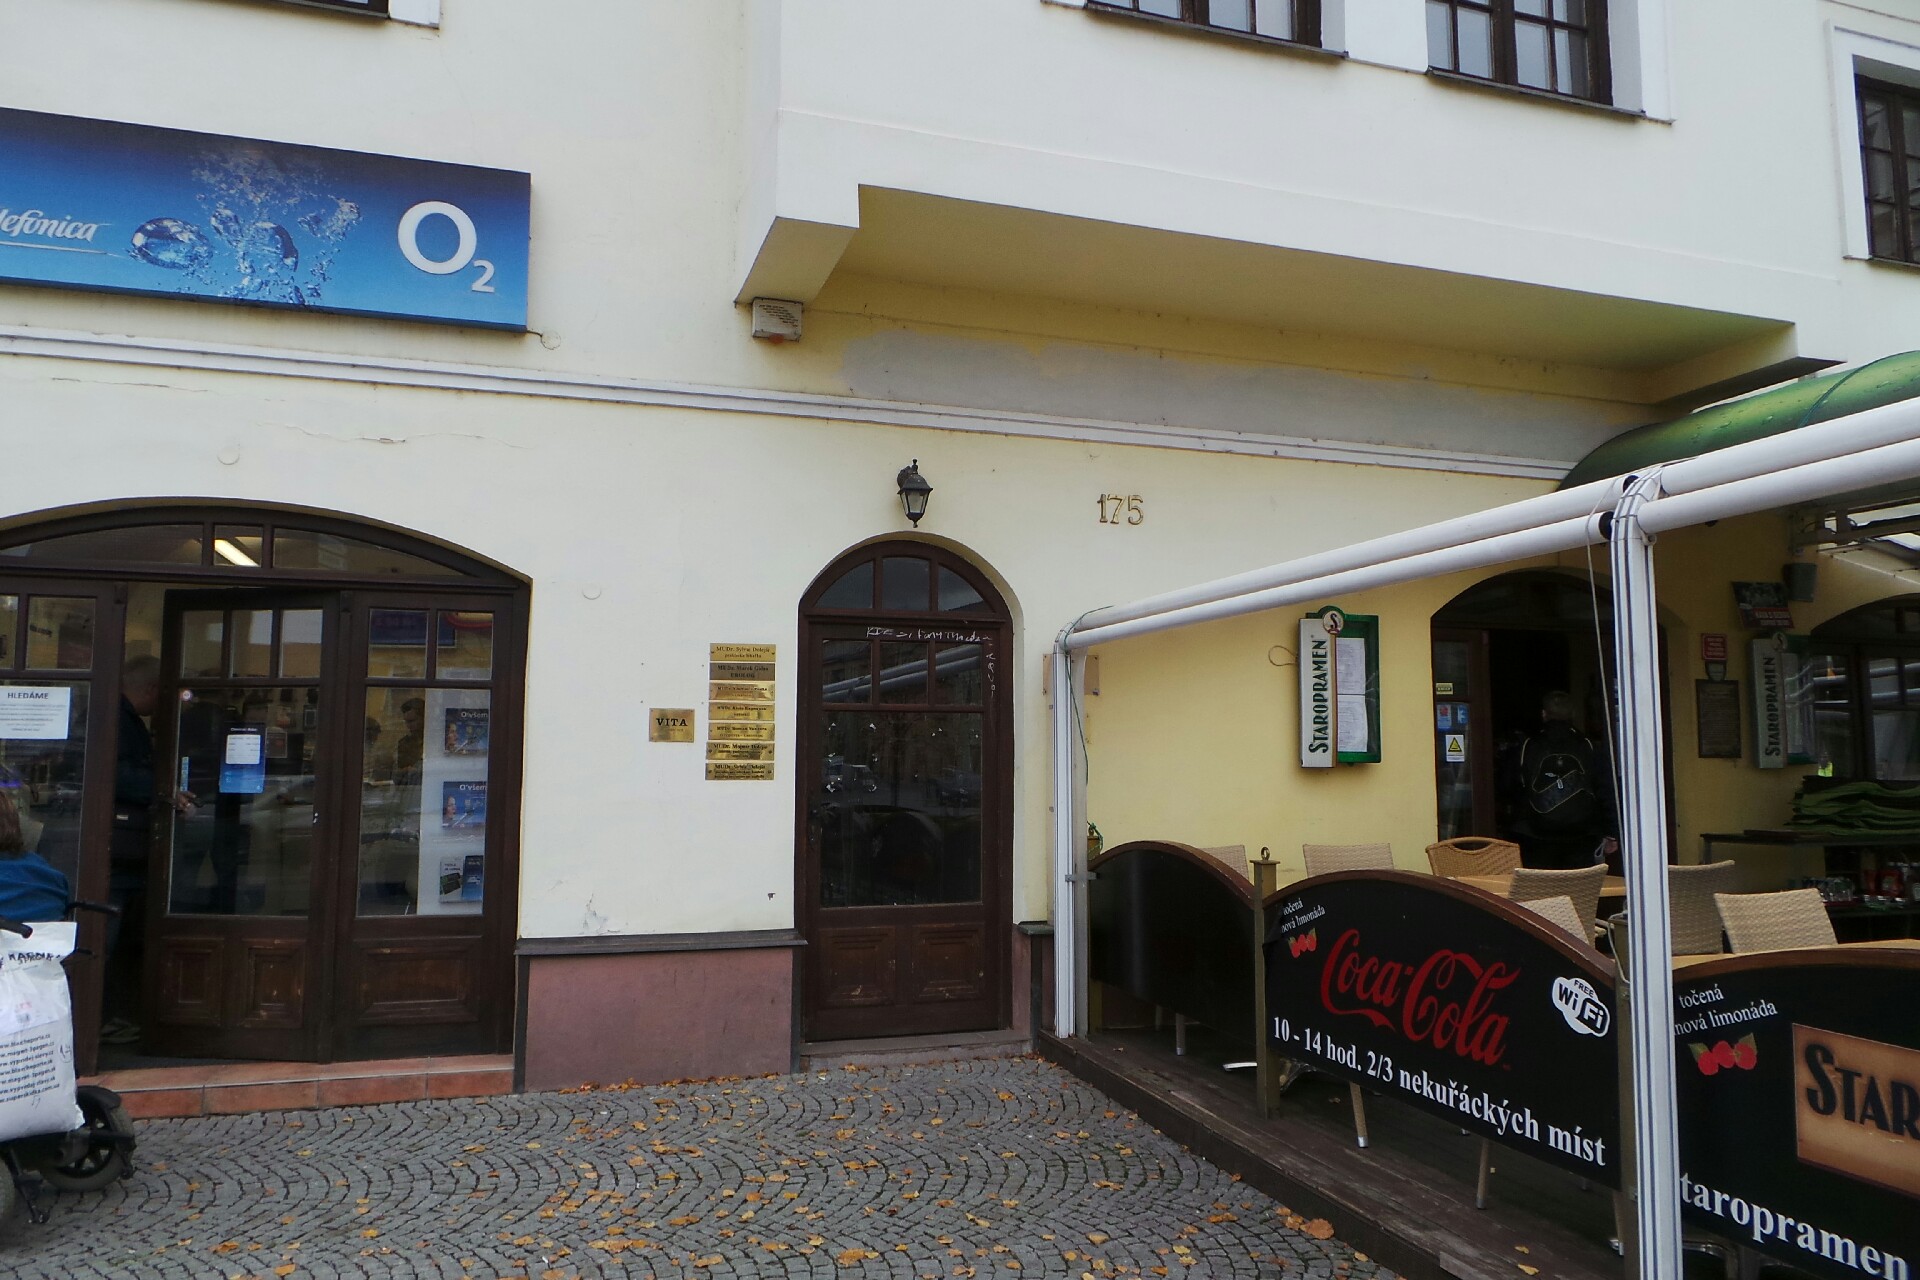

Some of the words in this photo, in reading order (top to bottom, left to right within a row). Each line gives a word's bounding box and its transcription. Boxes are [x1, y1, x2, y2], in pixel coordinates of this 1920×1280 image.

[1097, 493, 1144, 525] 175
[7, 691, 49, 700] HLEDÁME
[1308, 640, 1329, 753] STAROPRAMEN
[656, 718, 688, 727] VITA
[1574, 979, 1594, 998] FREE
[1679, 983, 1724, 1009] točená
[1708, 999, 1778, 1028] limonáda
[1273, 1016, 1290, 1042] 10
[1304, 1028, 1322, 1055] 14
[1326, 1035, 1362, 1071] hod.
[1367, 1051, 1394, 1082] 2/3
[1400, 1068, 1540, 1142] nekuřáckých
[1548, 1125, 1606, 1166] míst
[1805, 1043, 1920, 1140] STAR
[1680, 1172, 1910, 1280] taropramen
